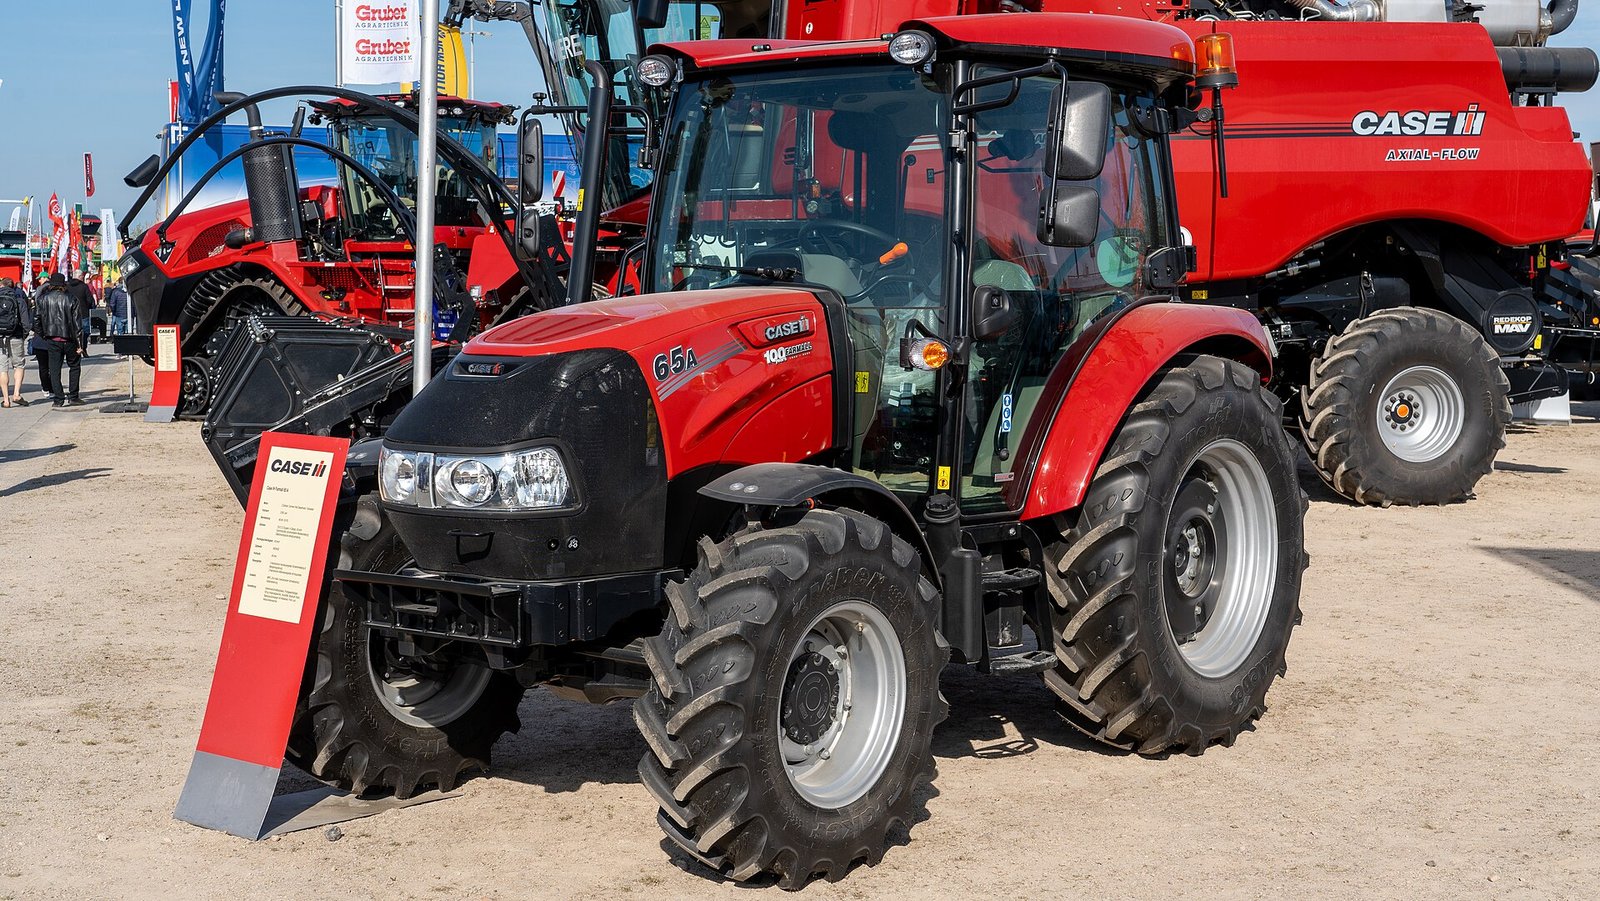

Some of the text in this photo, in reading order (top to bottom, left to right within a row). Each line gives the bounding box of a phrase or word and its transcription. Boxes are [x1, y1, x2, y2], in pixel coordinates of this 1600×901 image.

[355, 4, 407, 21] Gruber
[355, 21, 409, 29] AGRARTECHNIK
[175, 15, 190, 66] NEW
[355, 37, 411, 55] Gruber
[1351, 110, 1452, 136] CASE
[1385, 148, 1480, 161] AXIAL-FLOW
[765, 320, 799, 341] CASE
[1494, 323, 1531, 334] MAV
[785, 341, 813, 356] FARMALL
[468, 363, 491, 374] CASE
[271, 459, 312, 476] CASE
